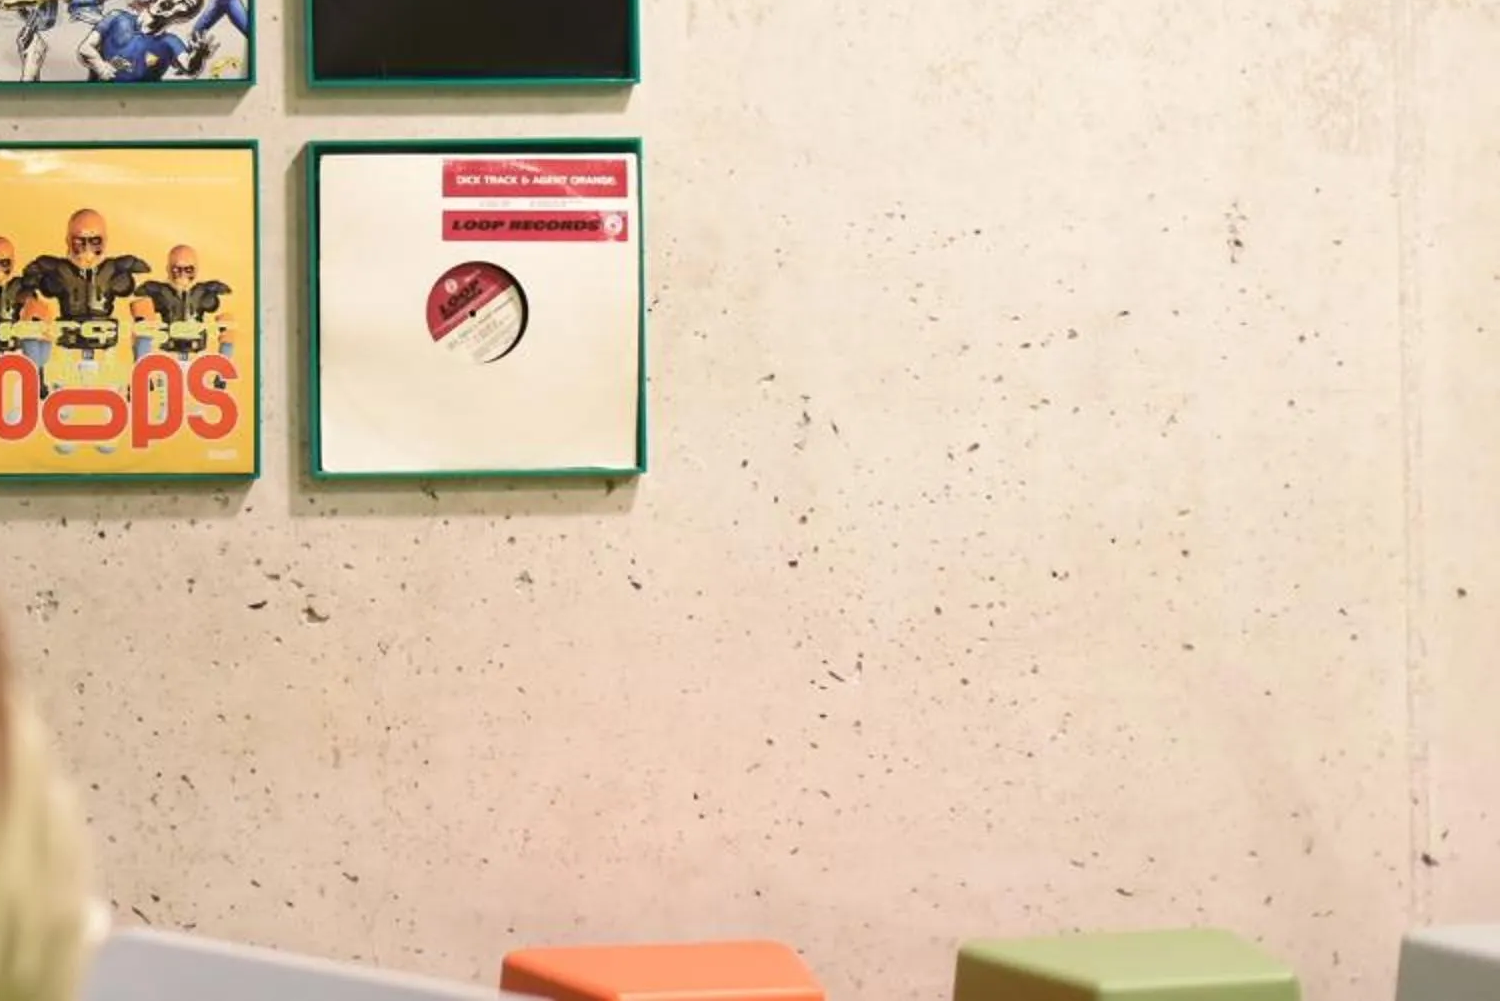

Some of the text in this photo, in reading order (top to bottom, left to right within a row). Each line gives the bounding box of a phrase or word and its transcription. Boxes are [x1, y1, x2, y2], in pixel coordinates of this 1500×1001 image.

[456, 174, 481, 186] DICK
[483, 174, 517, 186] TRACK
[531, 174, 568, 186] AGENT
[452, 219, 599, 232] LOOP RECORDS
